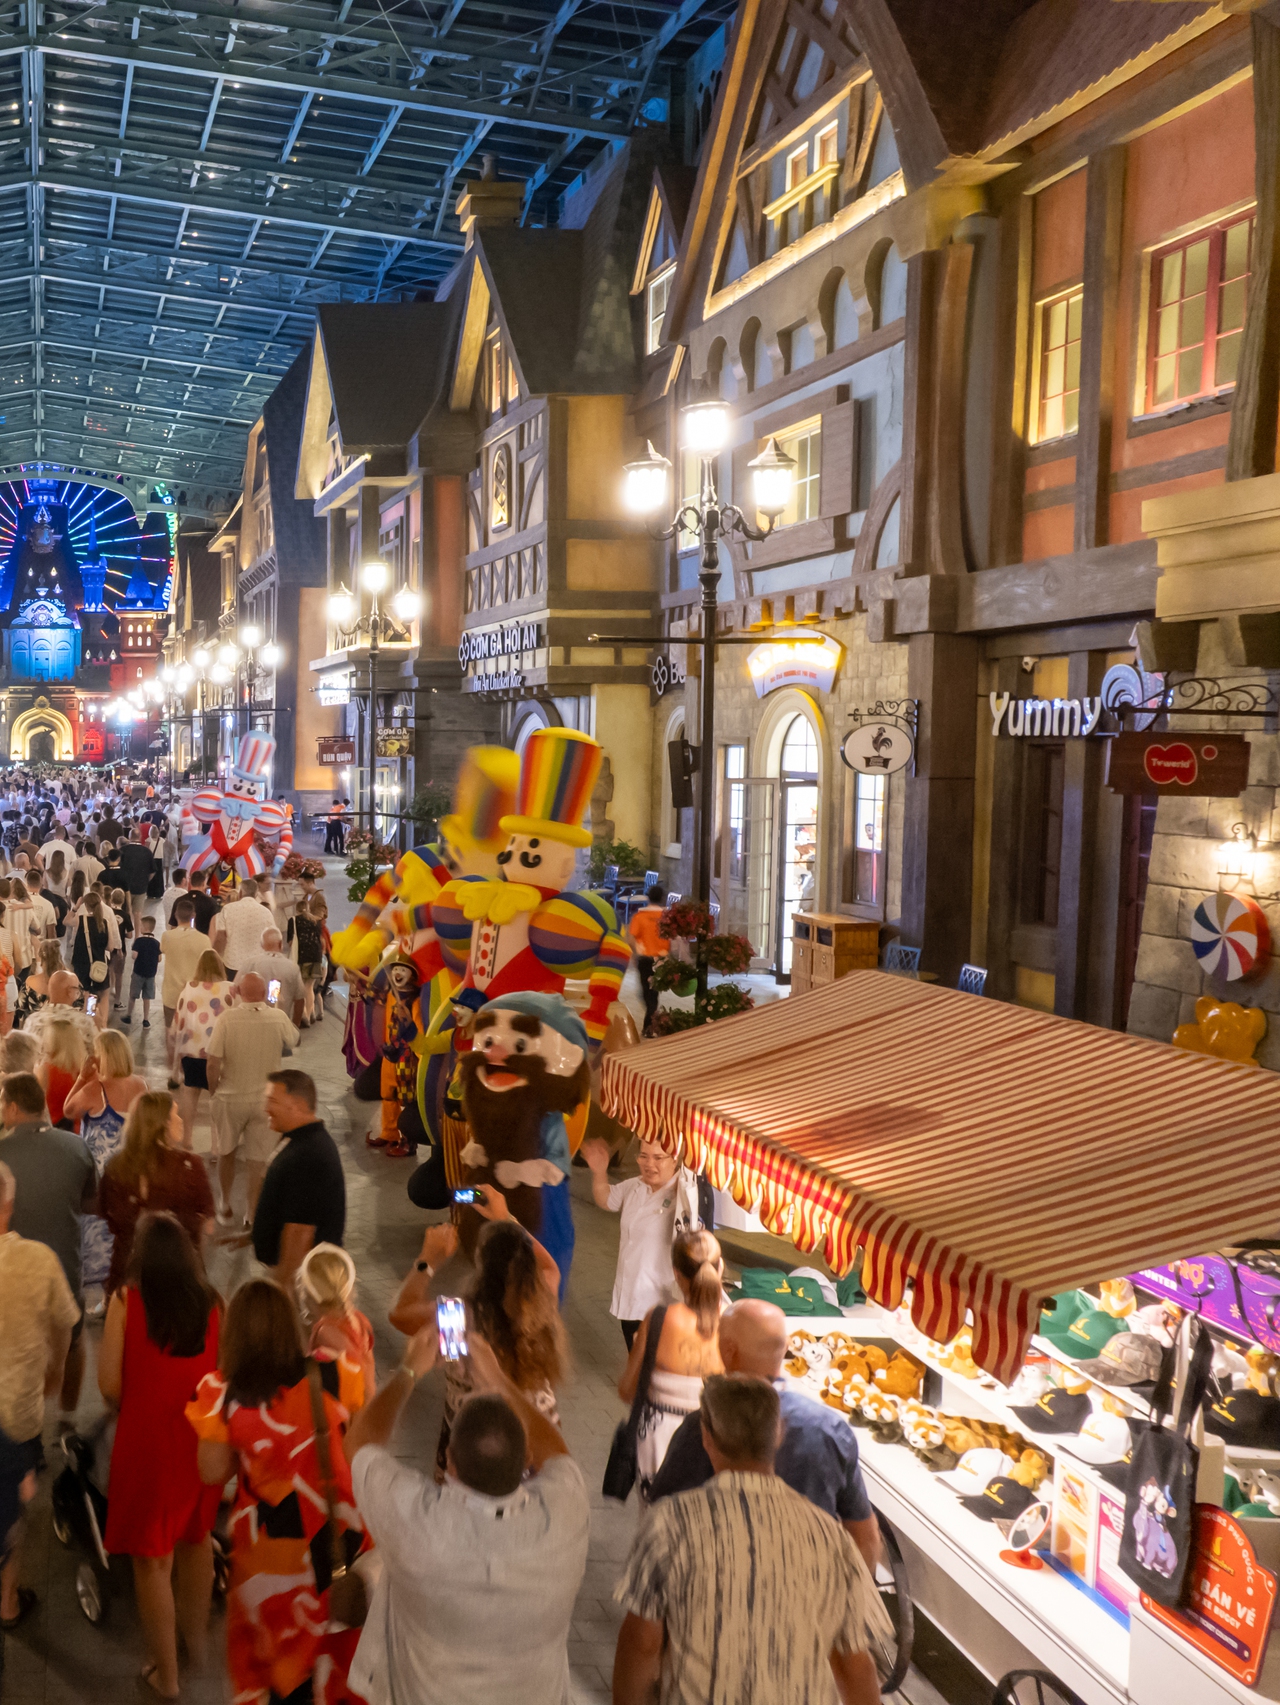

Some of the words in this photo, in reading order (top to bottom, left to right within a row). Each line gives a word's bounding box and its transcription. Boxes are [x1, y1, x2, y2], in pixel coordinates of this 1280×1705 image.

[470, 633, 489, 660] CƠM
[522, 623, 537, 650] AN
[989, 691, 1102, 737] Yummy
